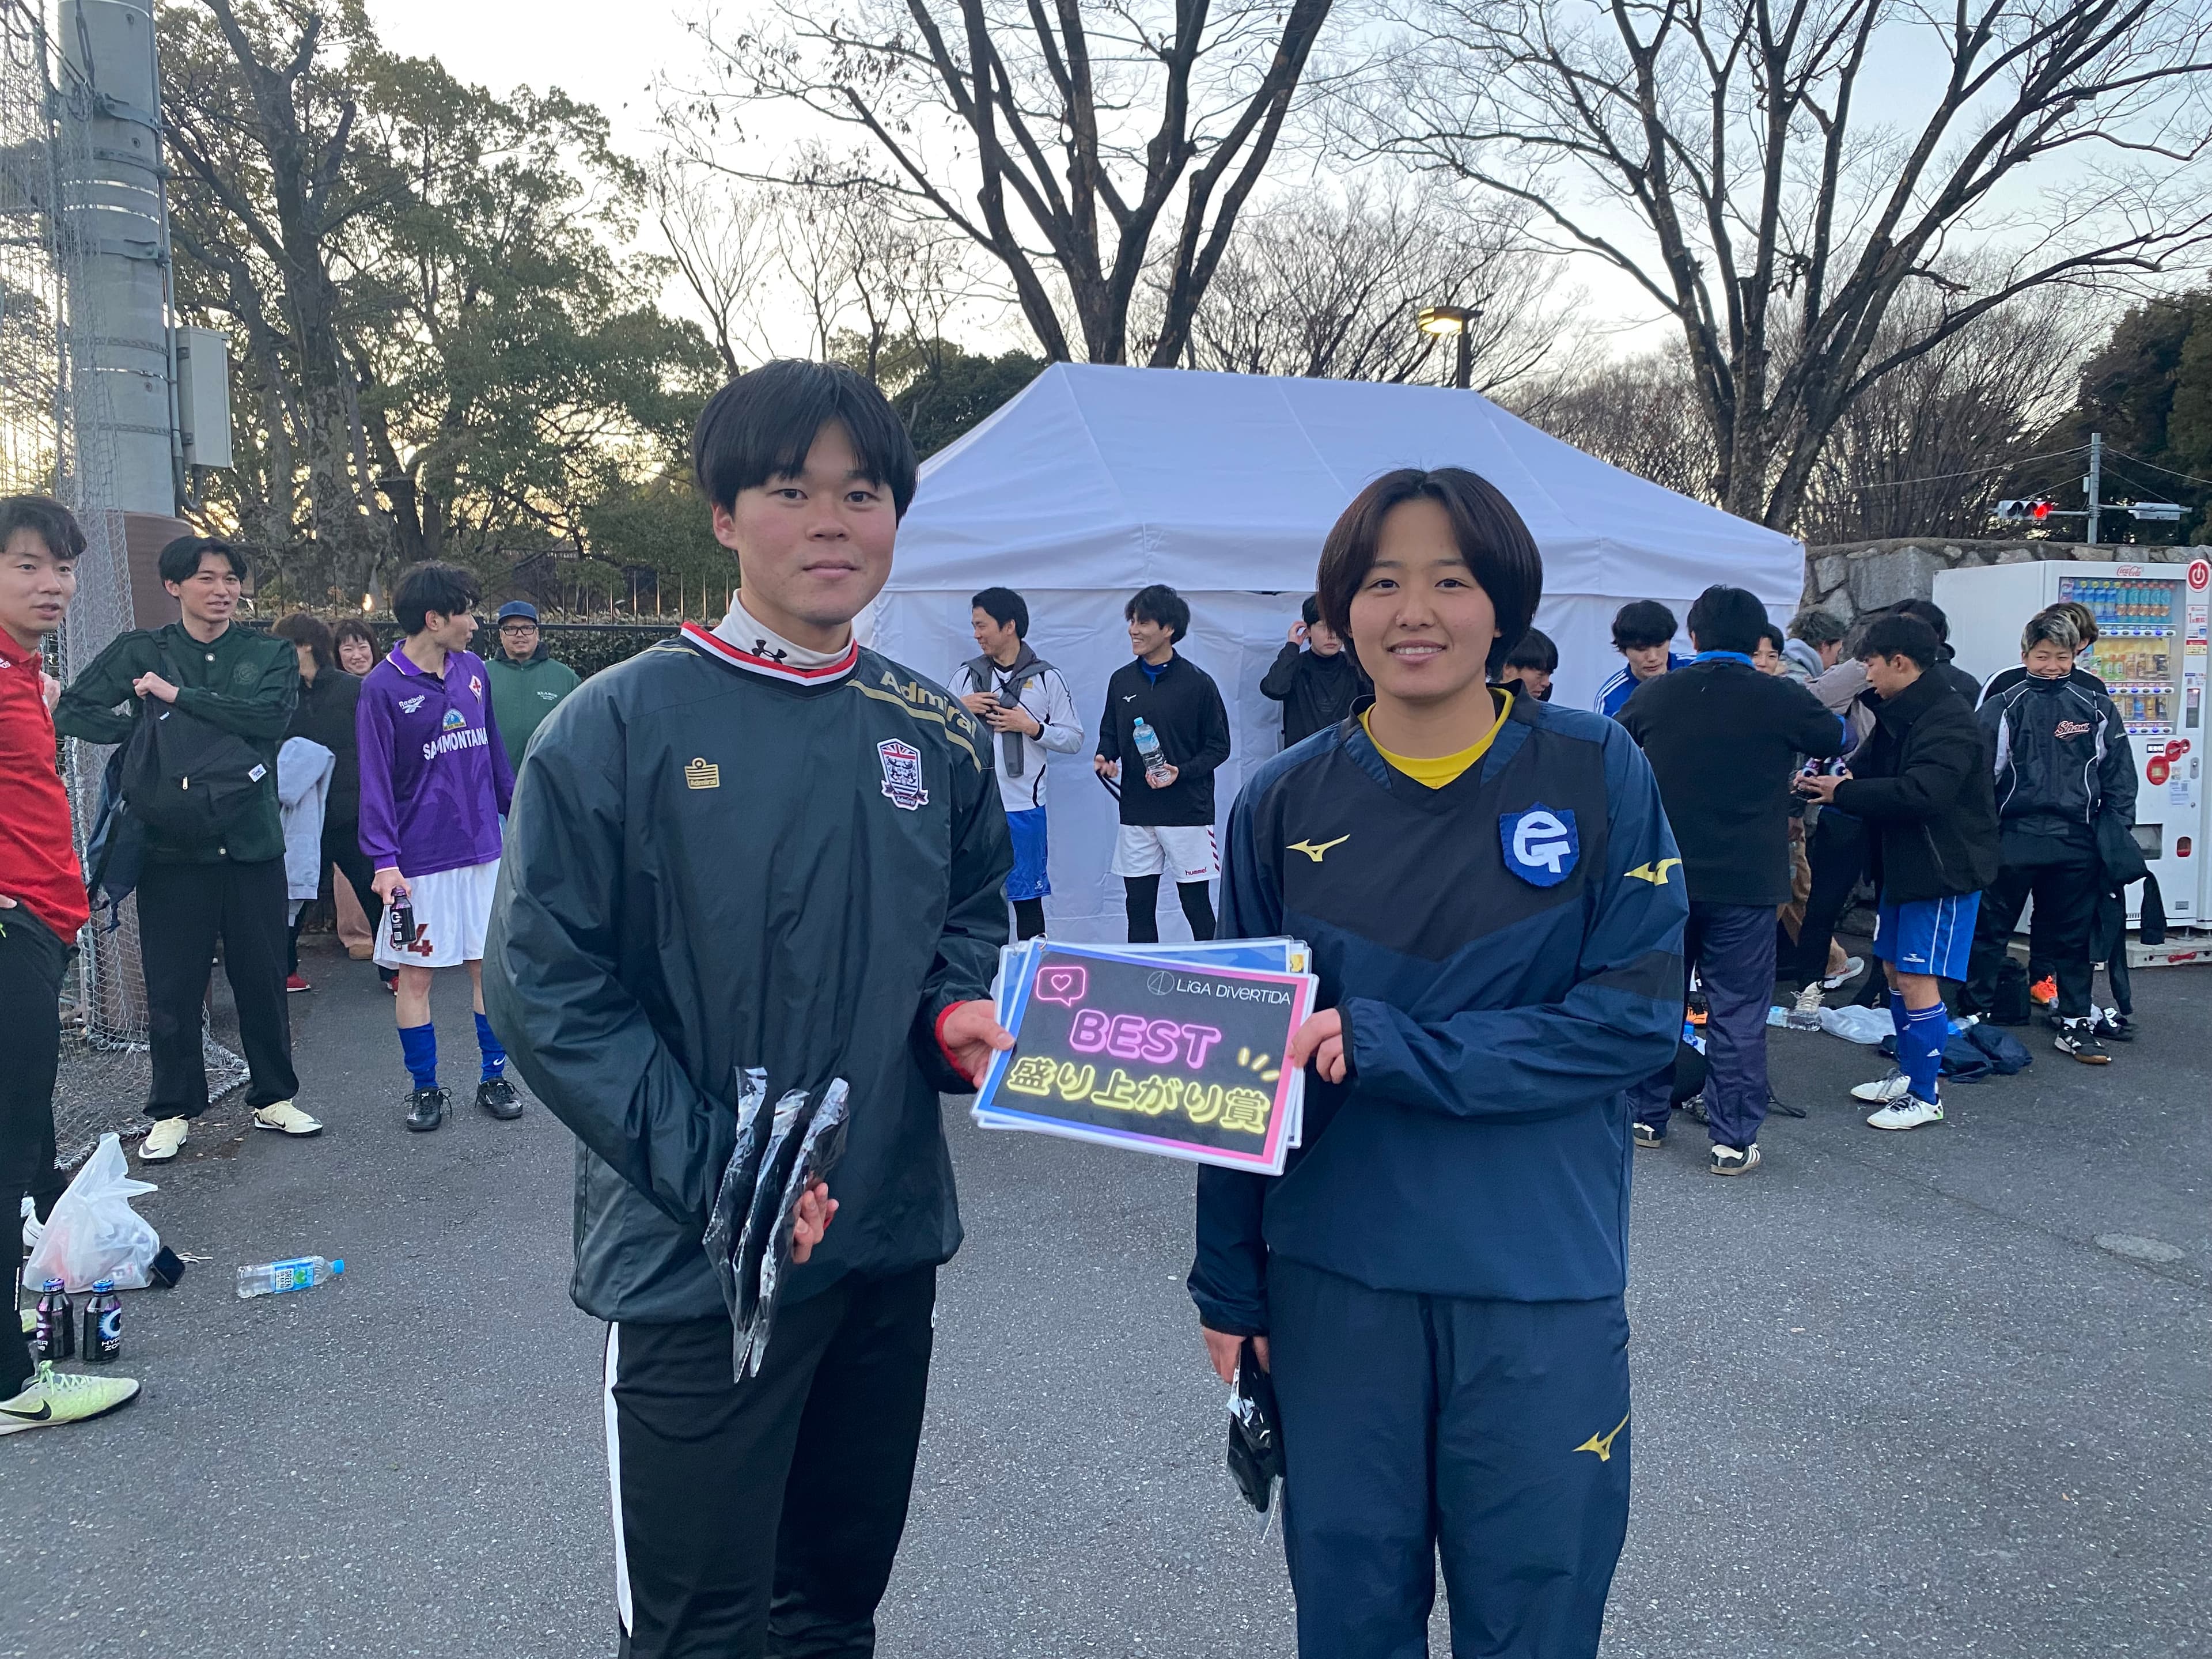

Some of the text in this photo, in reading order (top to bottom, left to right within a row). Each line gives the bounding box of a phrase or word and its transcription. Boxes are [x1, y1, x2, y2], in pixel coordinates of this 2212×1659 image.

[399, 694, 425, 708] Reebok
[880, 671, 977, 740] Admiral
[423, 728, 488, 760] SAMMONTANA
[1069, 1009, 1222, 1070] BEST
[1006, 1056, 1271, 1135] 盛り上がり賞
